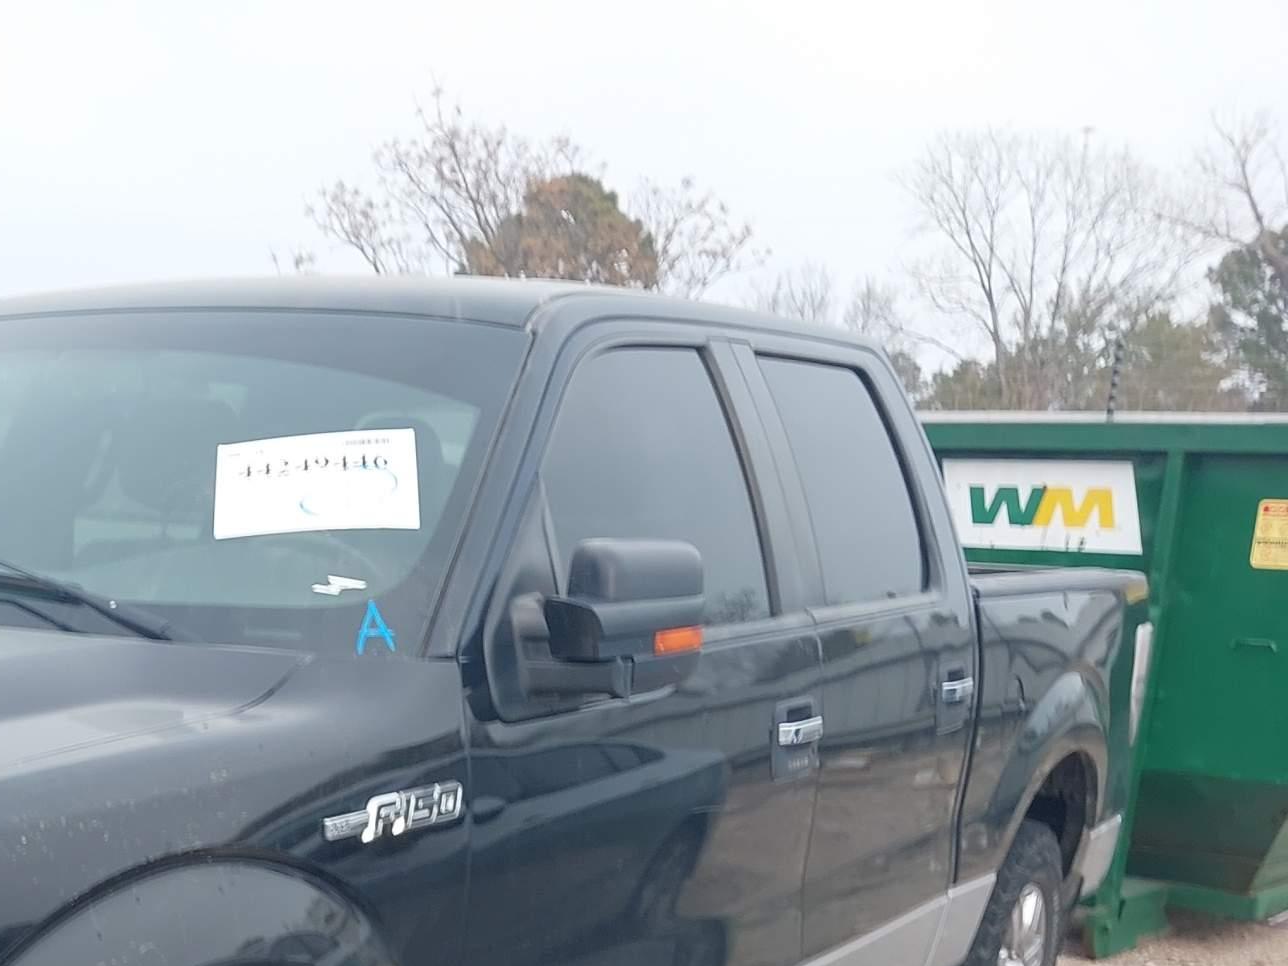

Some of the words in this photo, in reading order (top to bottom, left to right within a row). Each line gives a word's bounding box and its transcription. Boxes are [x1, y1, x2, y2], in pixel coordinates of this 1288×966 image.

[238, 453, 389, 479] 44249446
[969, 486, 1116, 528] WM
[356, 599, 396, 656] A
